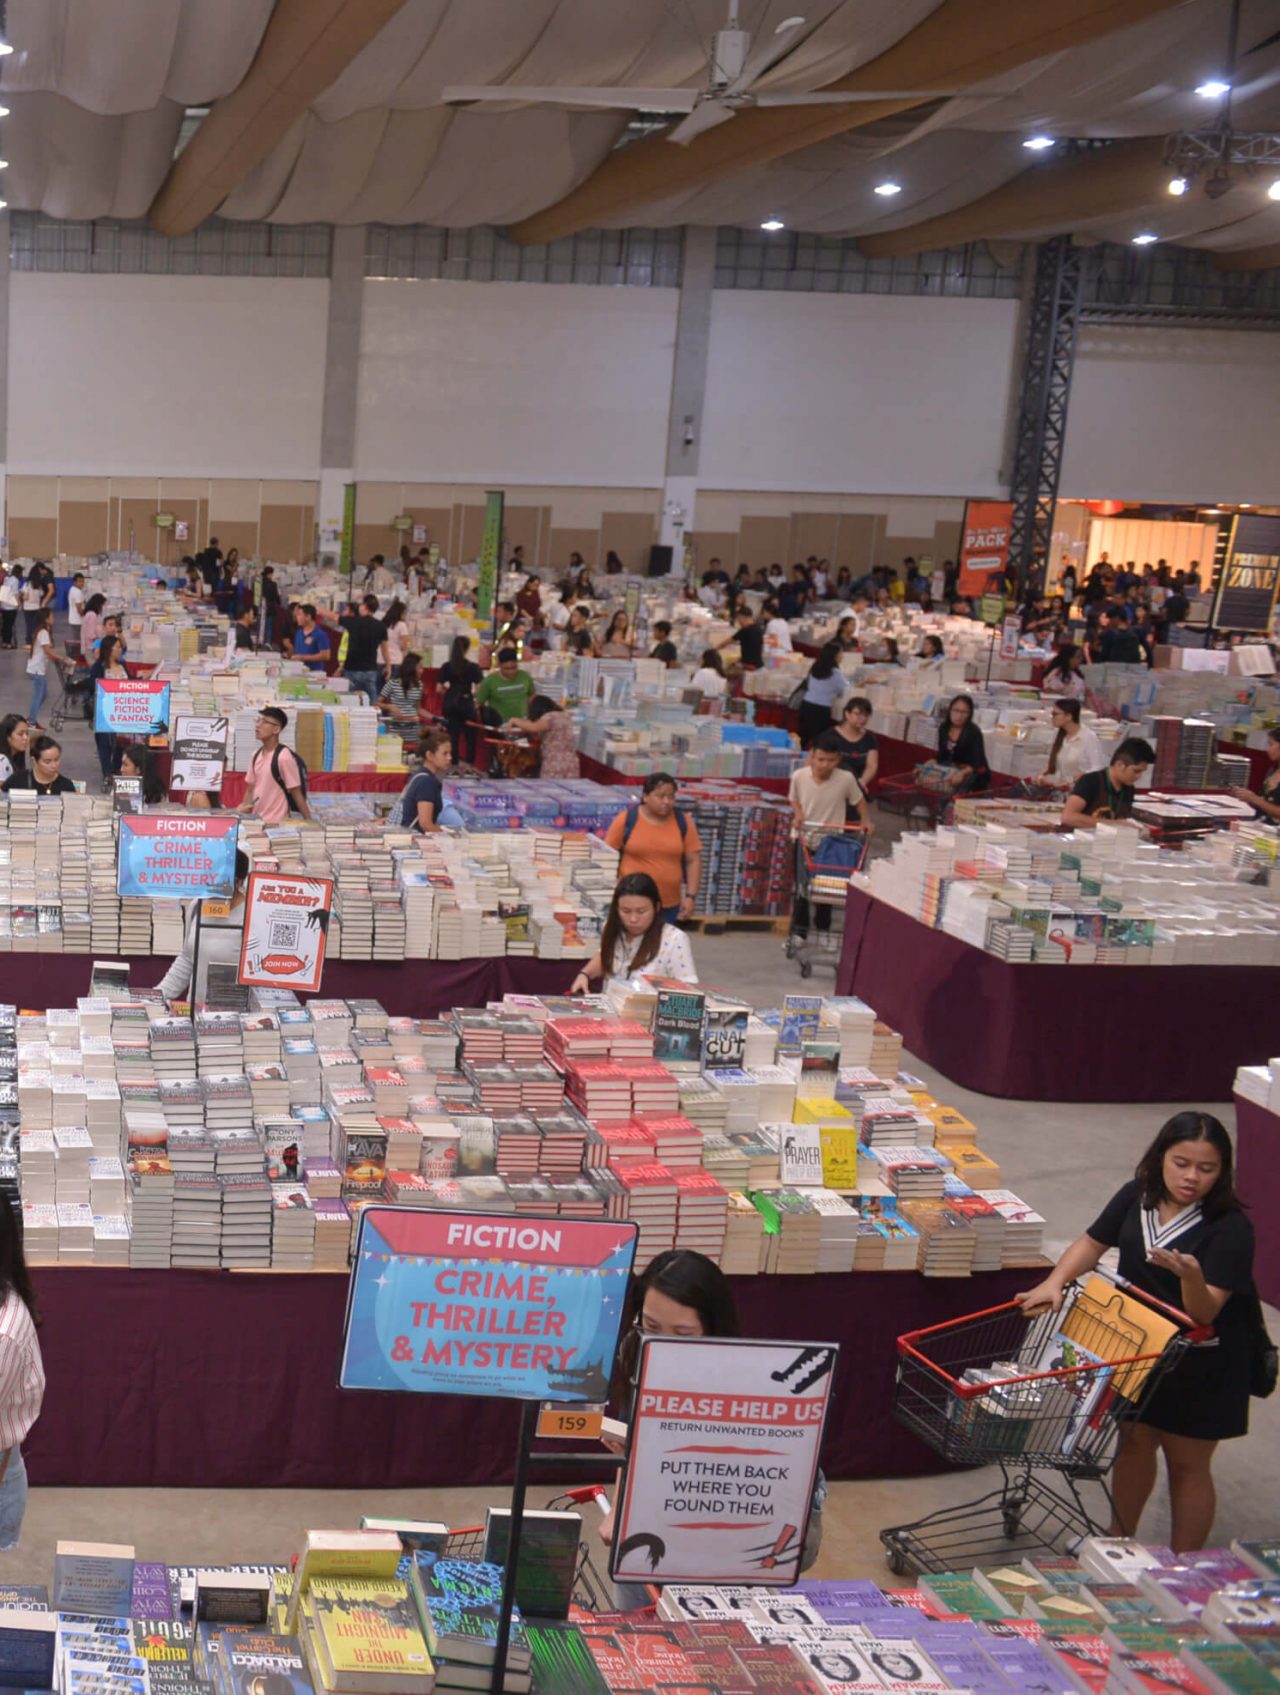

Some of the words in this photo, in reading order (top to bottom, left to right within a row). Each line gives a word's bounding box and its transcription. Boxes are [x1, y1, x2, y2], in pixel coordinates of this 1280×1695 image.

[965, 534, 1007, 548] PACK
[1228, 567, 1276, 589] ZONE
[118, 714, 155, 722] FANTASY
[116, 780, 140, 788] PETER
[156, 820, 207, 831] FICTION
[153, 841, 208, 857] CRIME,
[144, 857, 213, 870] THRILLER
[138, 872, 149, 883] &
[151, 873, 218, 885] MYSTERY
[277, 885, 297, 894] YOU
[209, 907, 224, 915] 160
[658, 1018, 676, 1028] Dark
[677, 1020, 700, 1029] Blood
[706, 1031, 744, 1041] FINAL
[706, 1041, 746, 1055] CUT
[785, 1147, 820, 1164] PRAYER
[346, 1180, 381, 1189] Fireproof
[447, 1223, 561, 1252] FICTION
[434, 1269, 556, 1309] CRIME,
[410, 1302, 567, 1338] THRILLER
[390, 1335, 414, 1362] &
[421, 1339, 578, 1372] MYSTERY
[640, 1395, 723, 1418] PLEASE
[730, 1401, 785, 1421] HELP
[794, 1402, 823, 1421] US
[558, 1416, 586, 1430] 159
[660, 1421, 703, 1434] RETURN
[705, 1424, 766, 1437] UNWANTED
[768, 1427, 805, 1439] BOOKS
[661, 1461, 692, 1477] PUT
[693, 1462, 740, 1479] THEM
[743, 1464, 790, 1480] BACK
[673, 1480, 732, 1496] WHERE
[735, 1482, 772, 1498] YOU
[664, 1499, 724, 1515] FOUND
[726, 1501, 775, 1517] THEM
[352, 1610, 383, 1623] SUN
[137, 1621, 184, 1640] GUIL
[336, 1623, 409, 1640] MIDNIGHT
[271, 1646, 292, 1656] The
[368, 1640, 383, 1649] THE
[136, 1647, 187, 1661] KELLERMA
[353, 1648, 405, 1665] UNDER
[231, 1654, 303, 1669] BALDACCI
